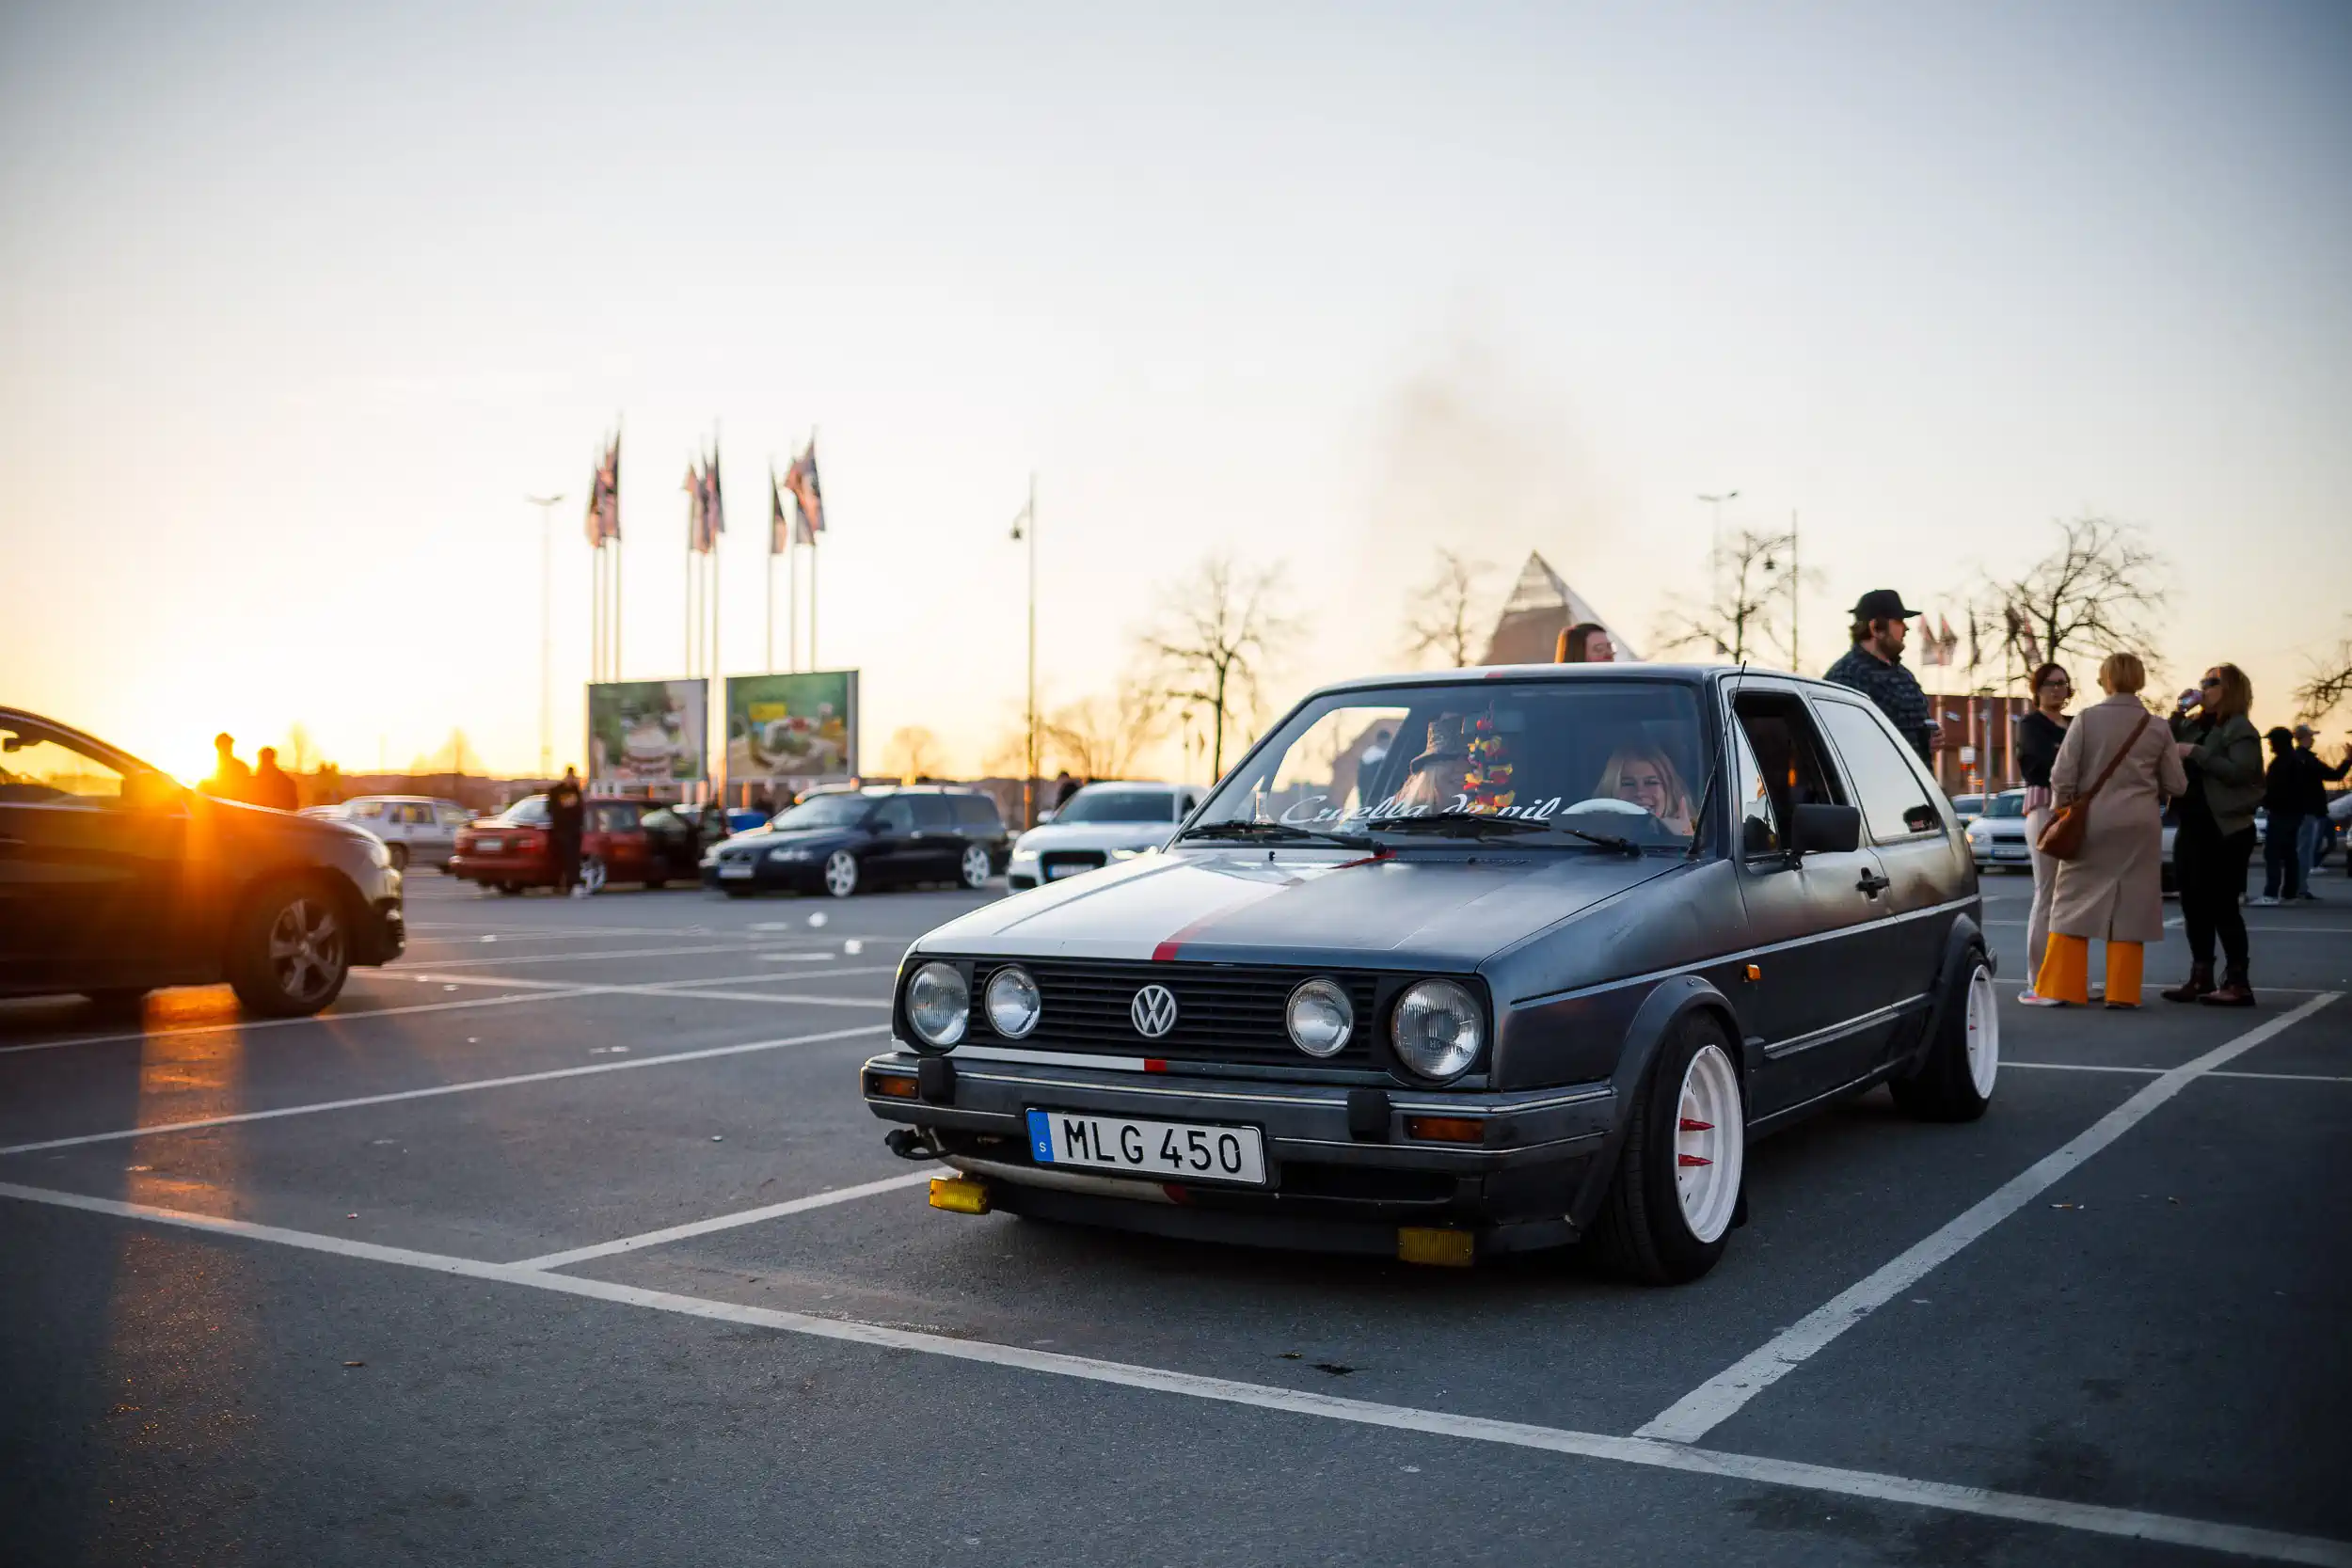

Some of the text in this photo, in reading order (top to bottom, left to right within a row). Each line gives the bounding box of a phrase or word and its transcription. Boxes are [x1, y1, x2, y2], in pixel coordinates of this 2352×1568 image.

[1279, 794, 1429, 825] Cruella
[1132, 985, 1176, 1037] VW
[1039, 1142, 1047, 1153] S
[1063, 1119, 1242, 1174] MLG 450
